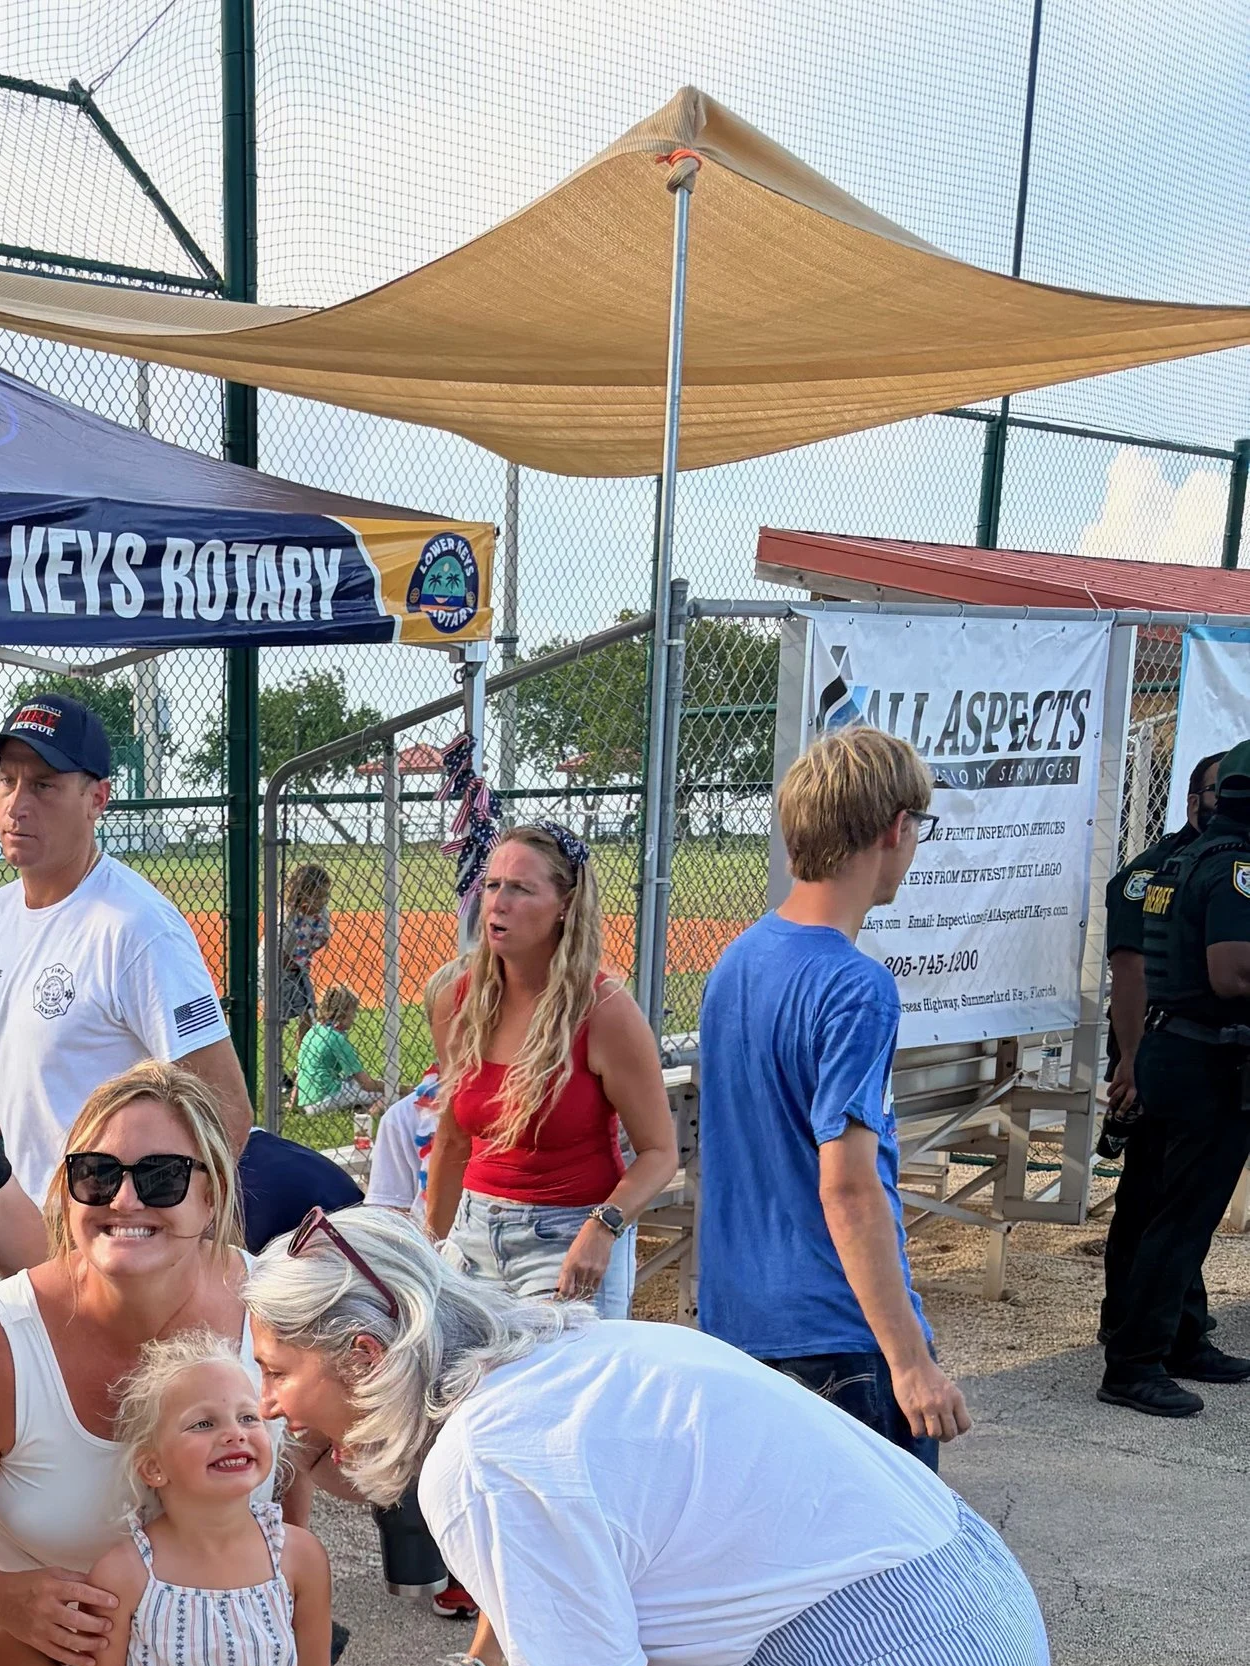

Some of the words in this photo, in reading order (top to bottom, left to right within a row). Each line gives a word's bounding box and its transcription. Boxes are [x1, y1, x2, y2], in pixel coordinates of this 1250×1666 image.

[420, 538, 455, 574] LOWER
[456, 540, 474, 576] KEYS
[7, 525, 147, 619] KEYS
[161, 537, 343, 622] ROTARY
[934, 689, 1091, 757] ASPECTS
[998, 762, 1074, 782] SERVICES
[976, 823, 1030, 840] INSPECTION
[1030, 821, 1066, 836] SERVICES
[909, 871, 933, 885] KEYS
[934, 869, 961, 884] FROM
[960, 868, 980, 883] KEY
[980, 867, 1006, 881] WEST
[1016, 864, 1034, 878] KEY
[1035, 862, 1062, 877] LARGO
[908, 915, 935, 929] Email:
[900, 1001, 922, 1014] rseas
[961, 989, 1010, 1006] Summerland
